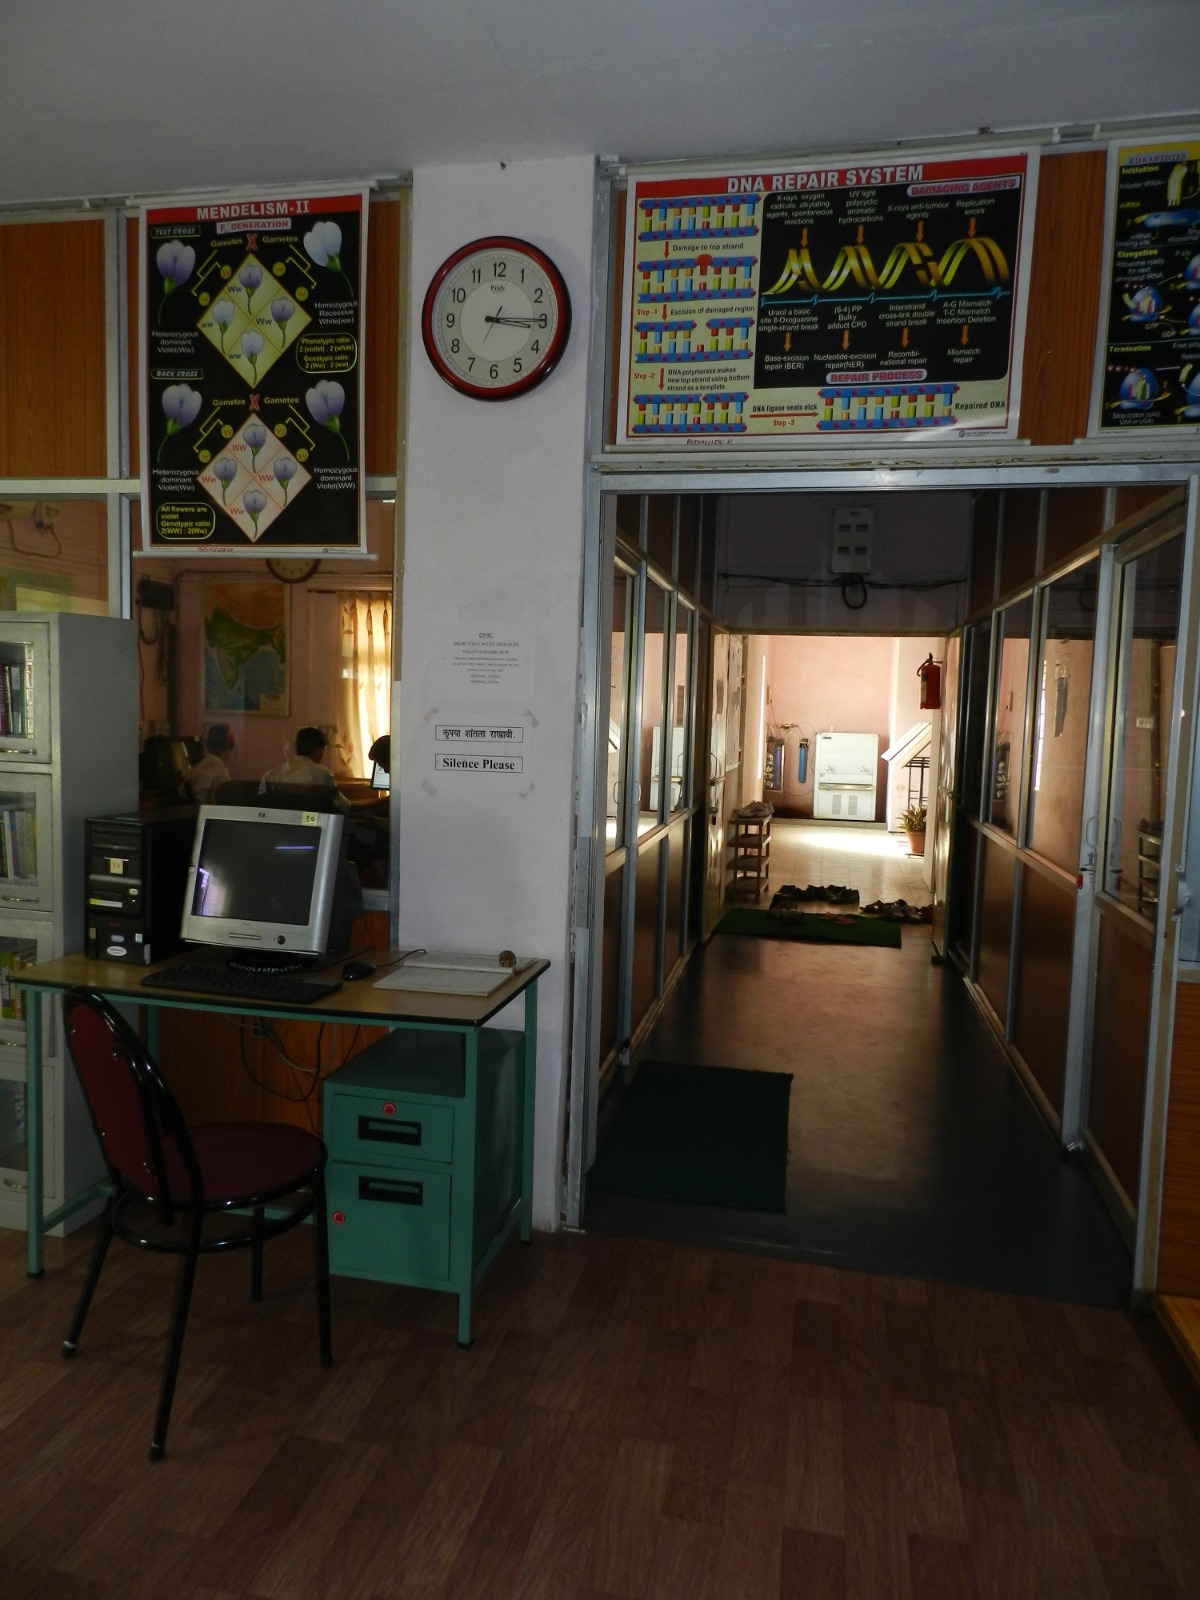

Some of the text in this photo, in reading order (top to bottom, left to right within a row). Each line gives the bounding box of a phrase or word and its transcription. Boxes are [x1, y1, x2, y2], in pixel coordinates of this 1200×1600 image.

[1122, 165, 1160, 174] Initiation
[727, 165, 923, 193] DNA REPAIR SYSTEM
[911, 178, 1017, 195] DAMAGING AGENTS
[800, 193, 825, 201] oxygen
[849, 189, 876, 198] UV light
[799, 201, 830, 209] alkylating
[845, 199, 879, 208] polycyclic
[887, 201, 950, 213] X-rays anti-tumour
[955, 198, 995, 208] Replication
[197, 200, 310, 220] MENDELISM-II
[791, 209, 833, 217] spontaneous
[838, 215, 884, 225] hydrocarbons
[906, 211, 929, 220] agents
[231, 220, 289, 230] GENERATION
[210, 238, 243, 248] Gametes
[262, 235, 299, 244] Gametes
[672, 245, 699, 253] Damage
[709, 243, 721, 251] top
[1117, 249, 1158, 258] Elongation
[493, 262, 506, 277] 12
[471, 269, 481, 283] 11
[520, 268, 525, 283] 1
[452, 288, 466, 303] 10
[534, 288, 543, 303] 2
[315, 301, 358, 309] Homozygous
[889, 302, 926, 311] Interstrand
[958, 300, 992, 308] Mismatch
[319, 309, 354, 317] Recessive
[704, 306, 733, 314] damaged
[734, 305, 755, 313] region
[957, 307, 991, 315] Mismatch
[838, 313, 857, 321] Bulky
[878, 310, 935, 319] cross-link double
[446, 313, 455, 328] 9
[538, 314, 548, 329] 3
[908, 318, 927, 326] break
[936, 315, 996, 324] Insertion Deletion
[758, 324, 799, 332] single-strand
[451, 338, 460, 353] 8
[531, 339, 540, 354] 4
[1109, 345, 1151, 353] Termination
[888, 350, 920, 358] Recombi-
[947, 348, 981, 356] Mismatch
[813, 353, 877, 361] Nucleotide-excision
[880, 357, 928, 366] national repair
[953, 356, 973, 364] repair
[468, 358, 475, 372] 7
[513, 358, 523, 373] 5
[764, 362, 804, 371] repair (BER)
[490, 364, 499, 379] 6
[682, 367, 715, 376] polymerase
[691, 375, 711, 383] strand
[711, 375, 728, 383] using
[830, 371, 922, 382] REPAIR PROCESS
[699, 383, 725, 391] template
[212, 398, 246, 407] Gametes
[955, 402, 988, 411] Repaired
[766, 405, 785, 413] ligase
[152, 468, 199, 476] Heterozygous
[313, 467, 358, 475] Homozygous
[443, 729, 461, 739] कृपया
[443, 758, 515, 770] Silence Please
